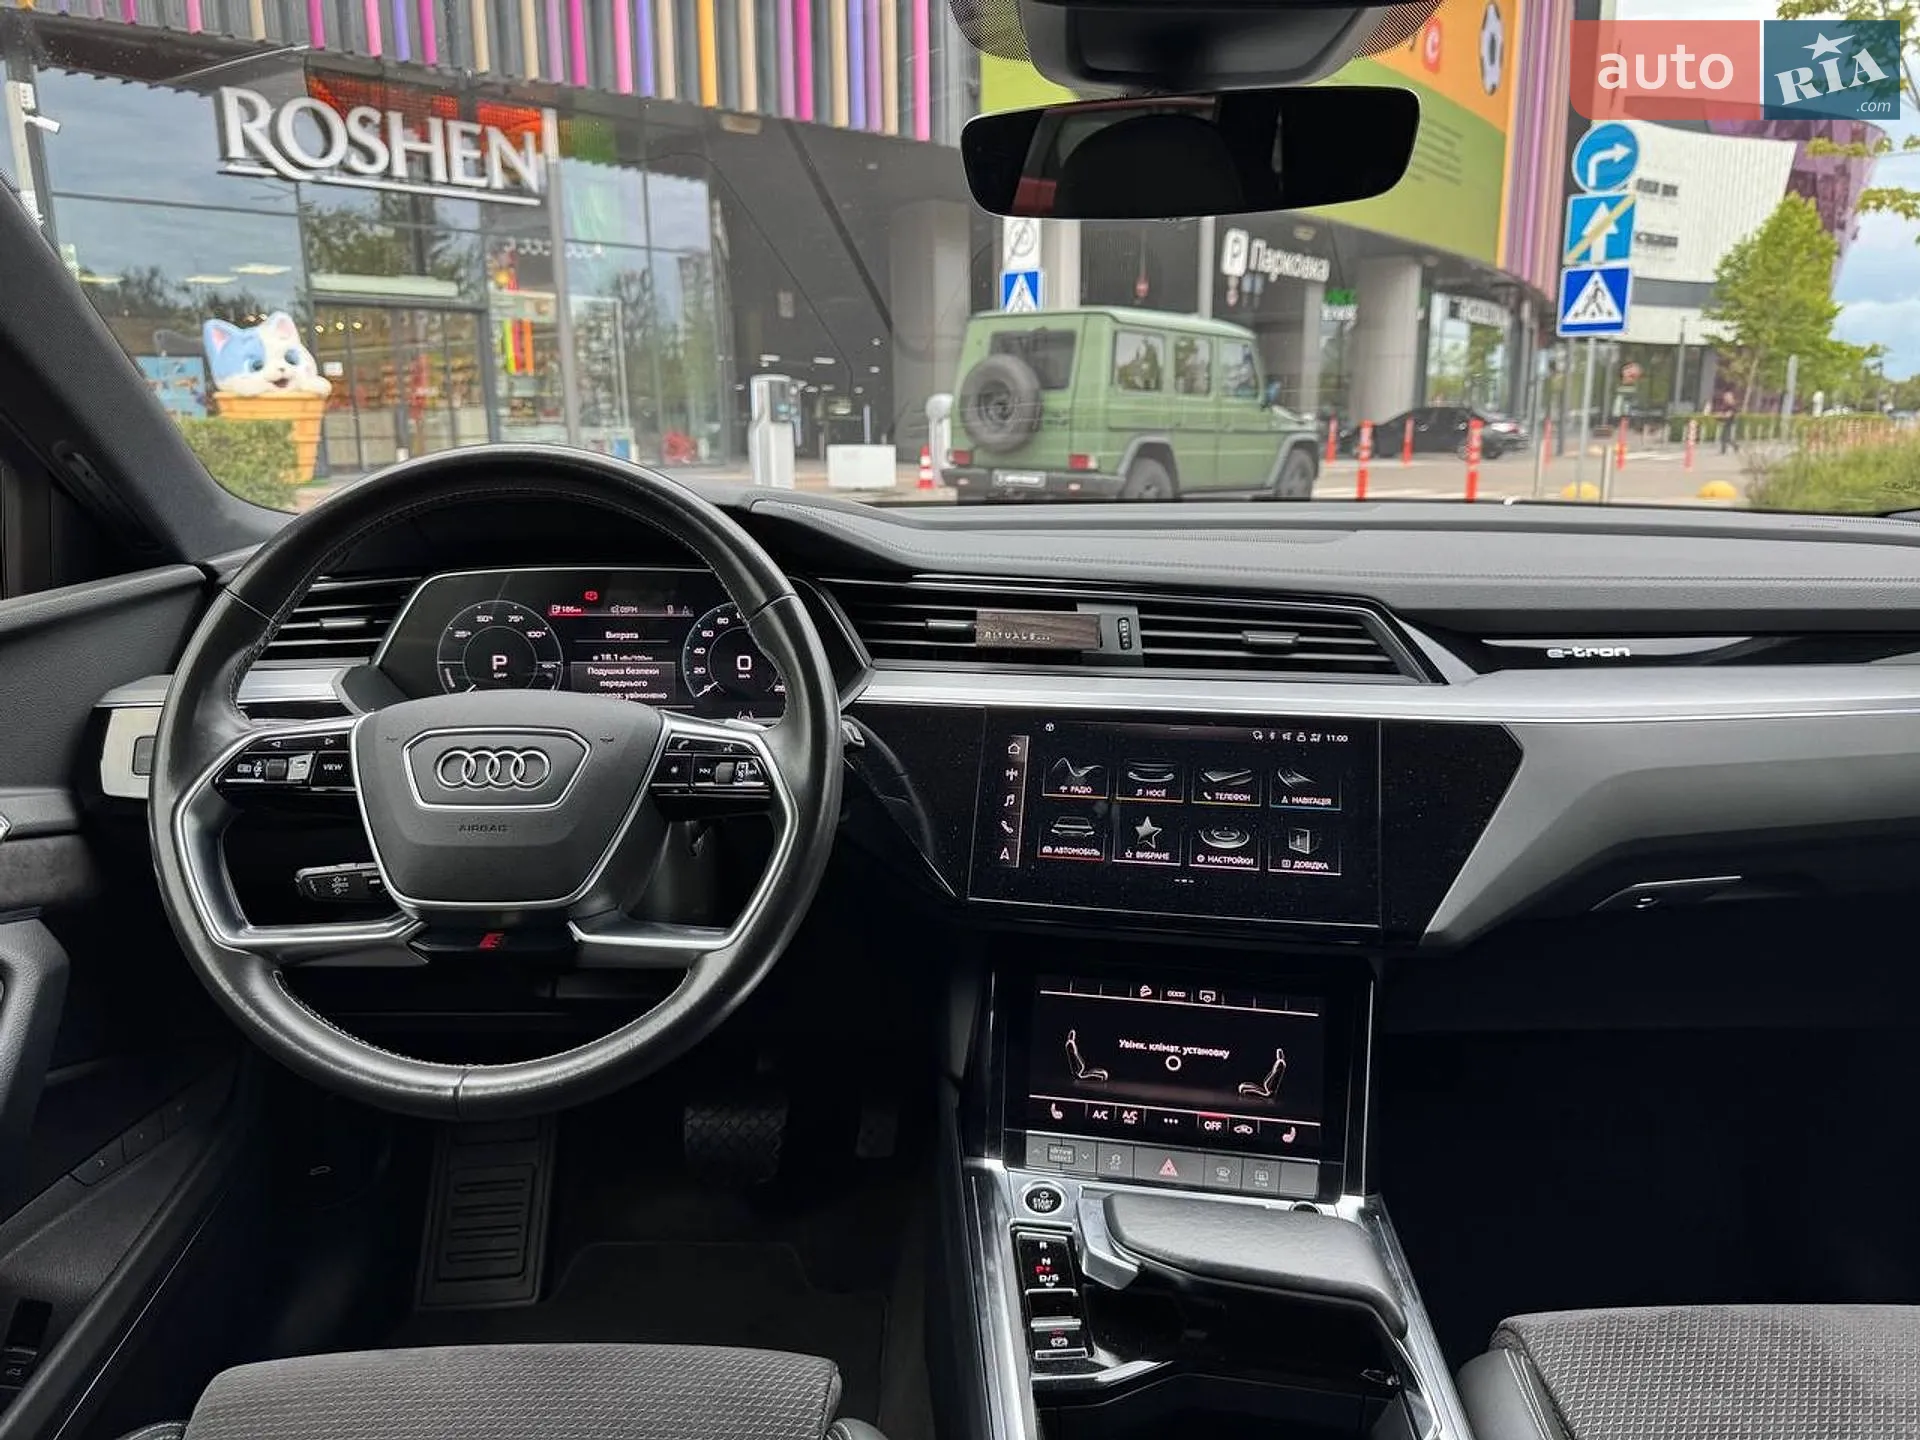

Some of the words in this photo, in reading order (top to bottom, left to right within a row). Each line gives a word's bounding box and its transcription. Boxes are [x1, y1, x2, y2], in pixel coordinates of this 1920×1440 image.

[218, 86, 541, 195] ROSHEN
[1249, 238, 1330, 282] Парковка
[717, 617, 729, 625] 80
[605, 631, 639, 640] Витрата
[693, 647, 706, 655] 40
[1546, 645, 1631, 659] e-tron
[491, 654, 509, 671] P
[736, 655, 752, 671] 0
[322, 763, 343, 772] VIEW
[1214, 791, 1251, 802] ТЕЛЕФОН
[1135, 851, 1170, 860] ВИБРАНЕ
[1092, 1109, 1109, 1121] A/C
[1122, 1110, 1139, 1121] A/C
[1204, 1120, 1222, 1131] OFF
[1041, 1257, 1051, 1266] N
